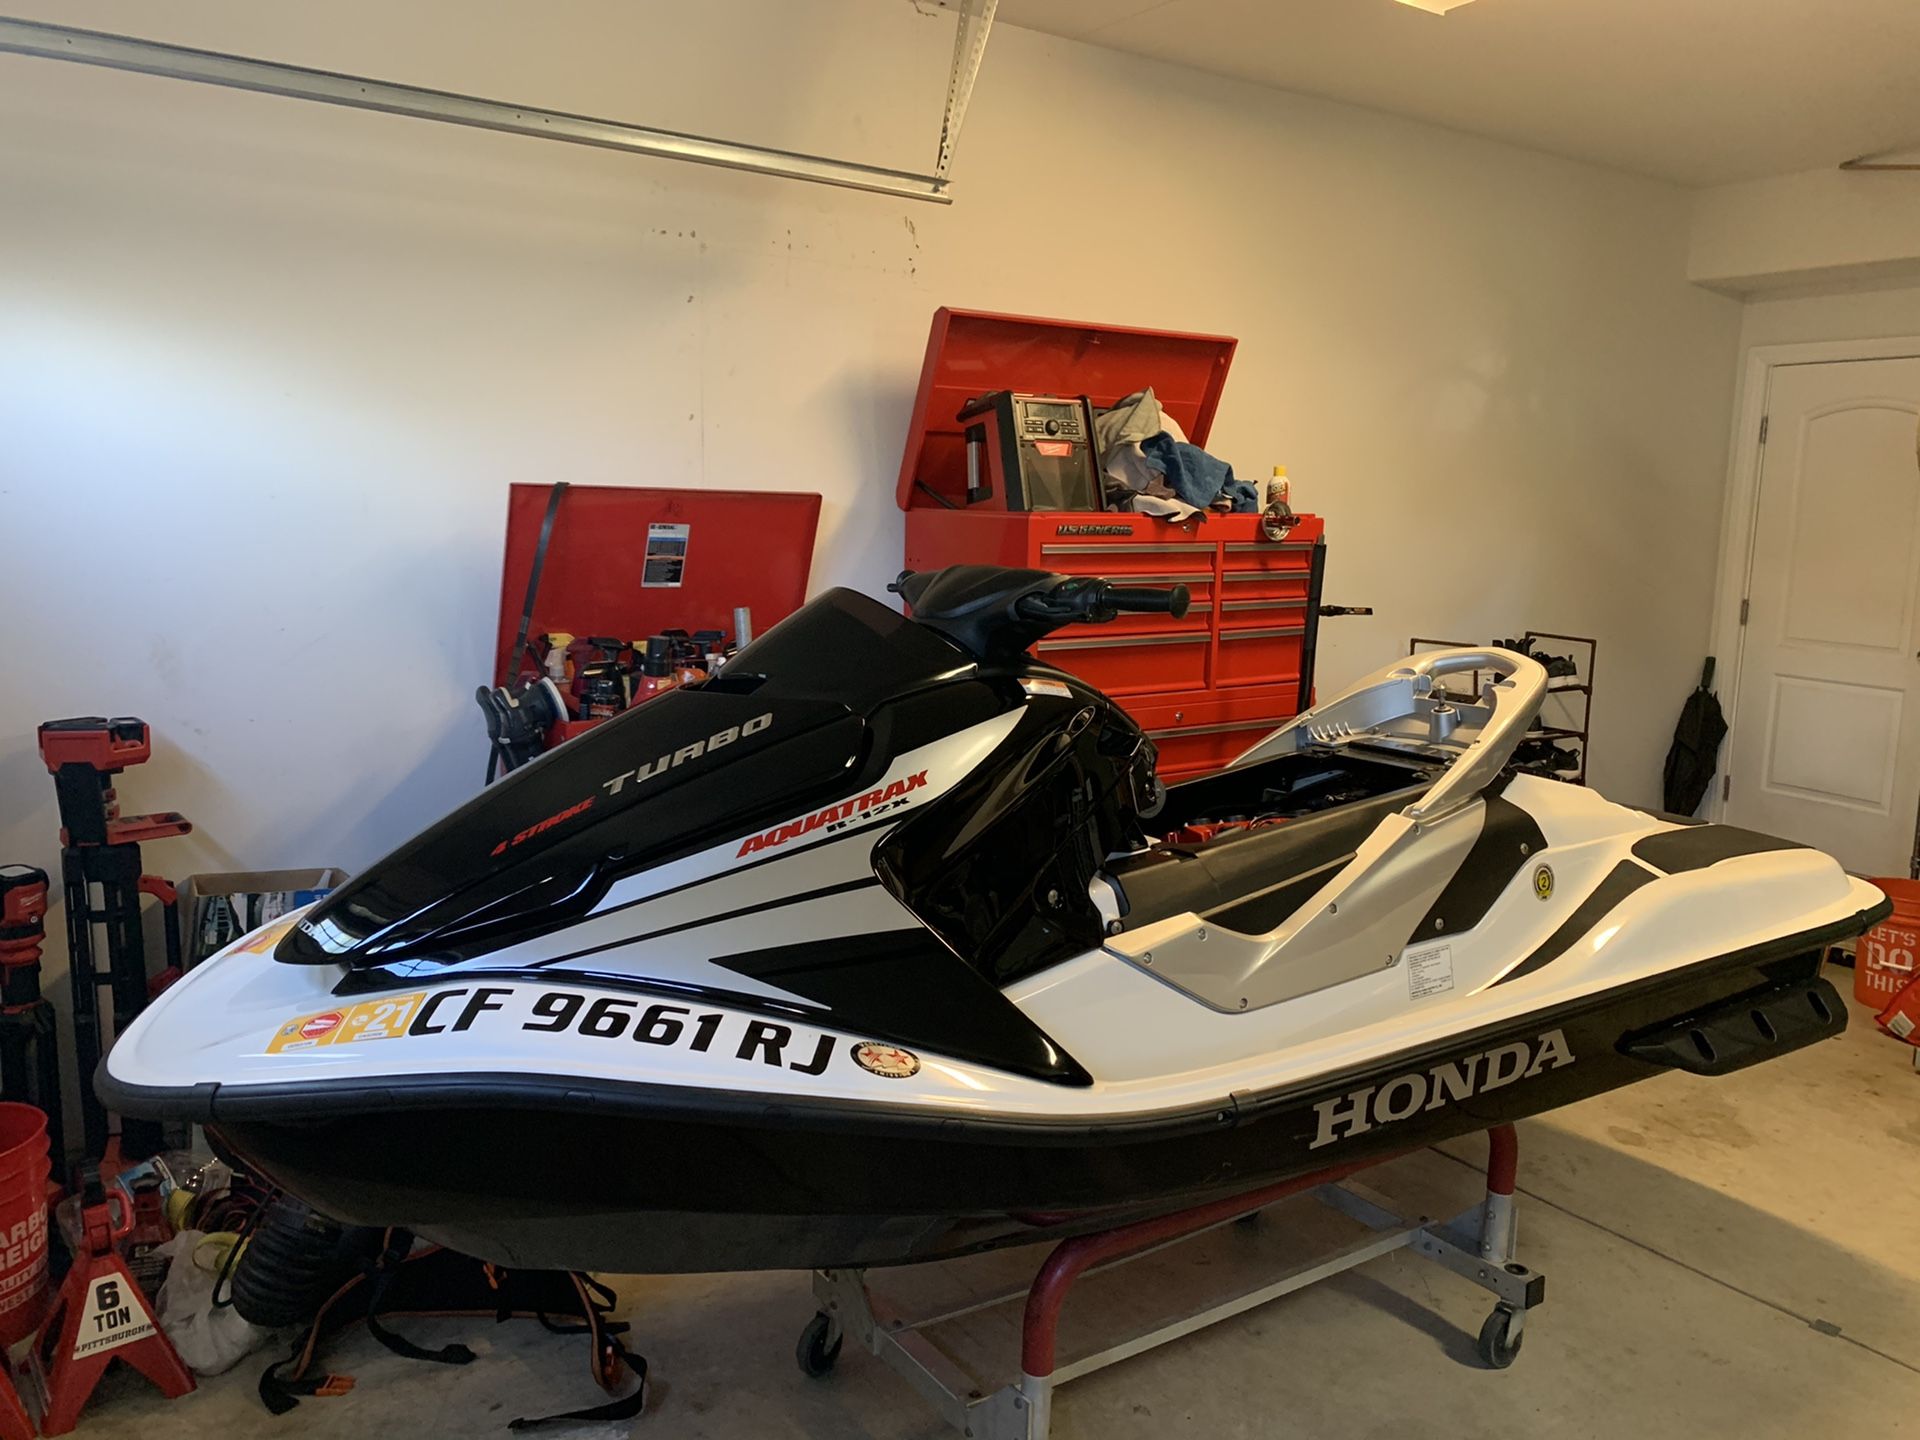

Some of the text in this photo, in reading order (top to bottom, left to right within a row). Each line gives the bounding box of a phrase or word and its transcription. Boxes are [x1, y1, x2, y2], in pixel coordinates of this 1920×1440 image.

[602, 712, 773, 796] TURBO
[490, 795, 596, 857] 4 STROKE
[736, 769, 928, 859] AQUATRAX
[1868, 927, 1917, 947] LET'S
[1867, 941, 1914, 975] DO
[364, 1001, 414, 1032] 21
[408, 988, 837, 1076] CF 9661 RJ
[1309, 1028, 1576, 1150] HONDA
[96, 1280, 120, 1311] 6
[93, 1306, 131, 1333] TON
[80, 1324, 146, 1353] PITTSBURGH
